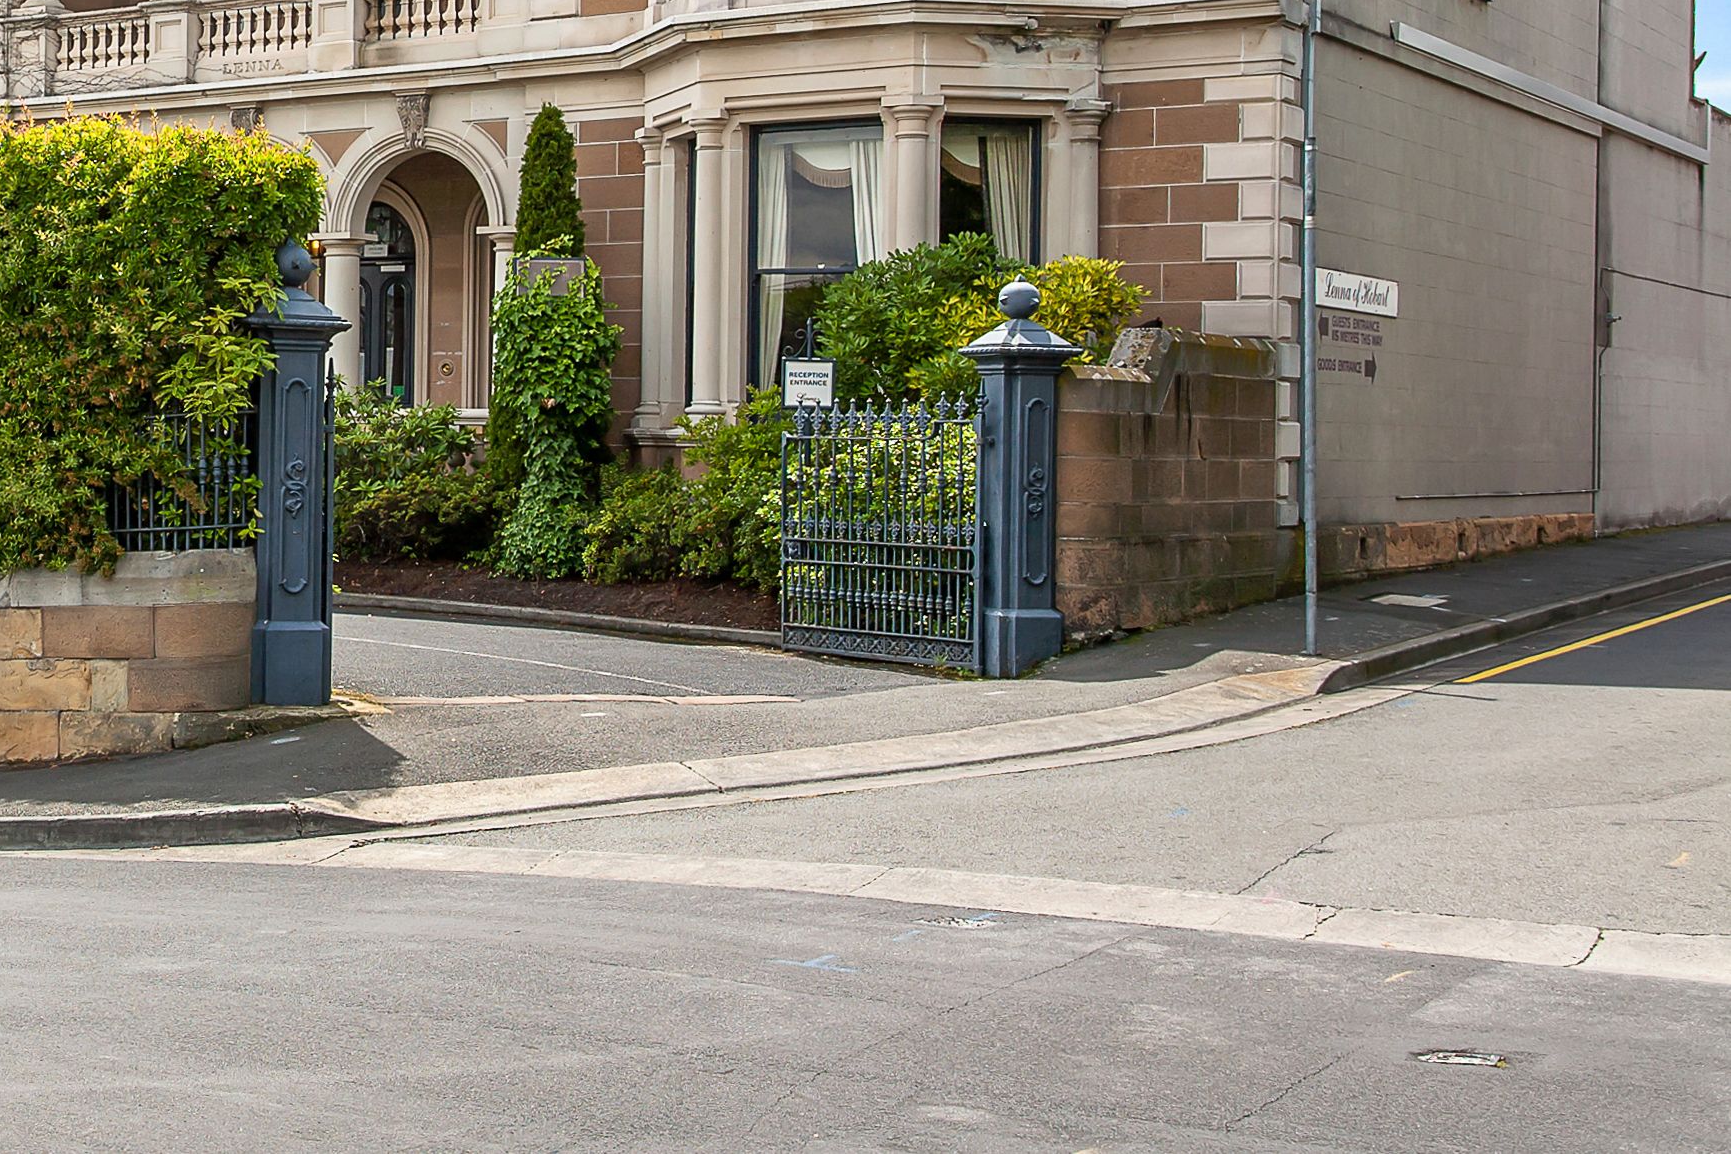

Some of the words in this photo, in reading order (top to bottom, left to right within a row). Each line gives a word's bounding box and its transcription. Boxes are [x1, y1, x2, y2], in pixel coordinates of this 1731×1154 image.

[222, 59, 285, 75] LENNA
[1324, 271, 1352, 301] Lenna
[1361, 279, 1390, 308] Hobart
[1352, 318, 1381, 333] ENTRANCE
[1316, 357, 1337, 371] GOODS
[1337, 359, 1362, 374] ENTRANCE
